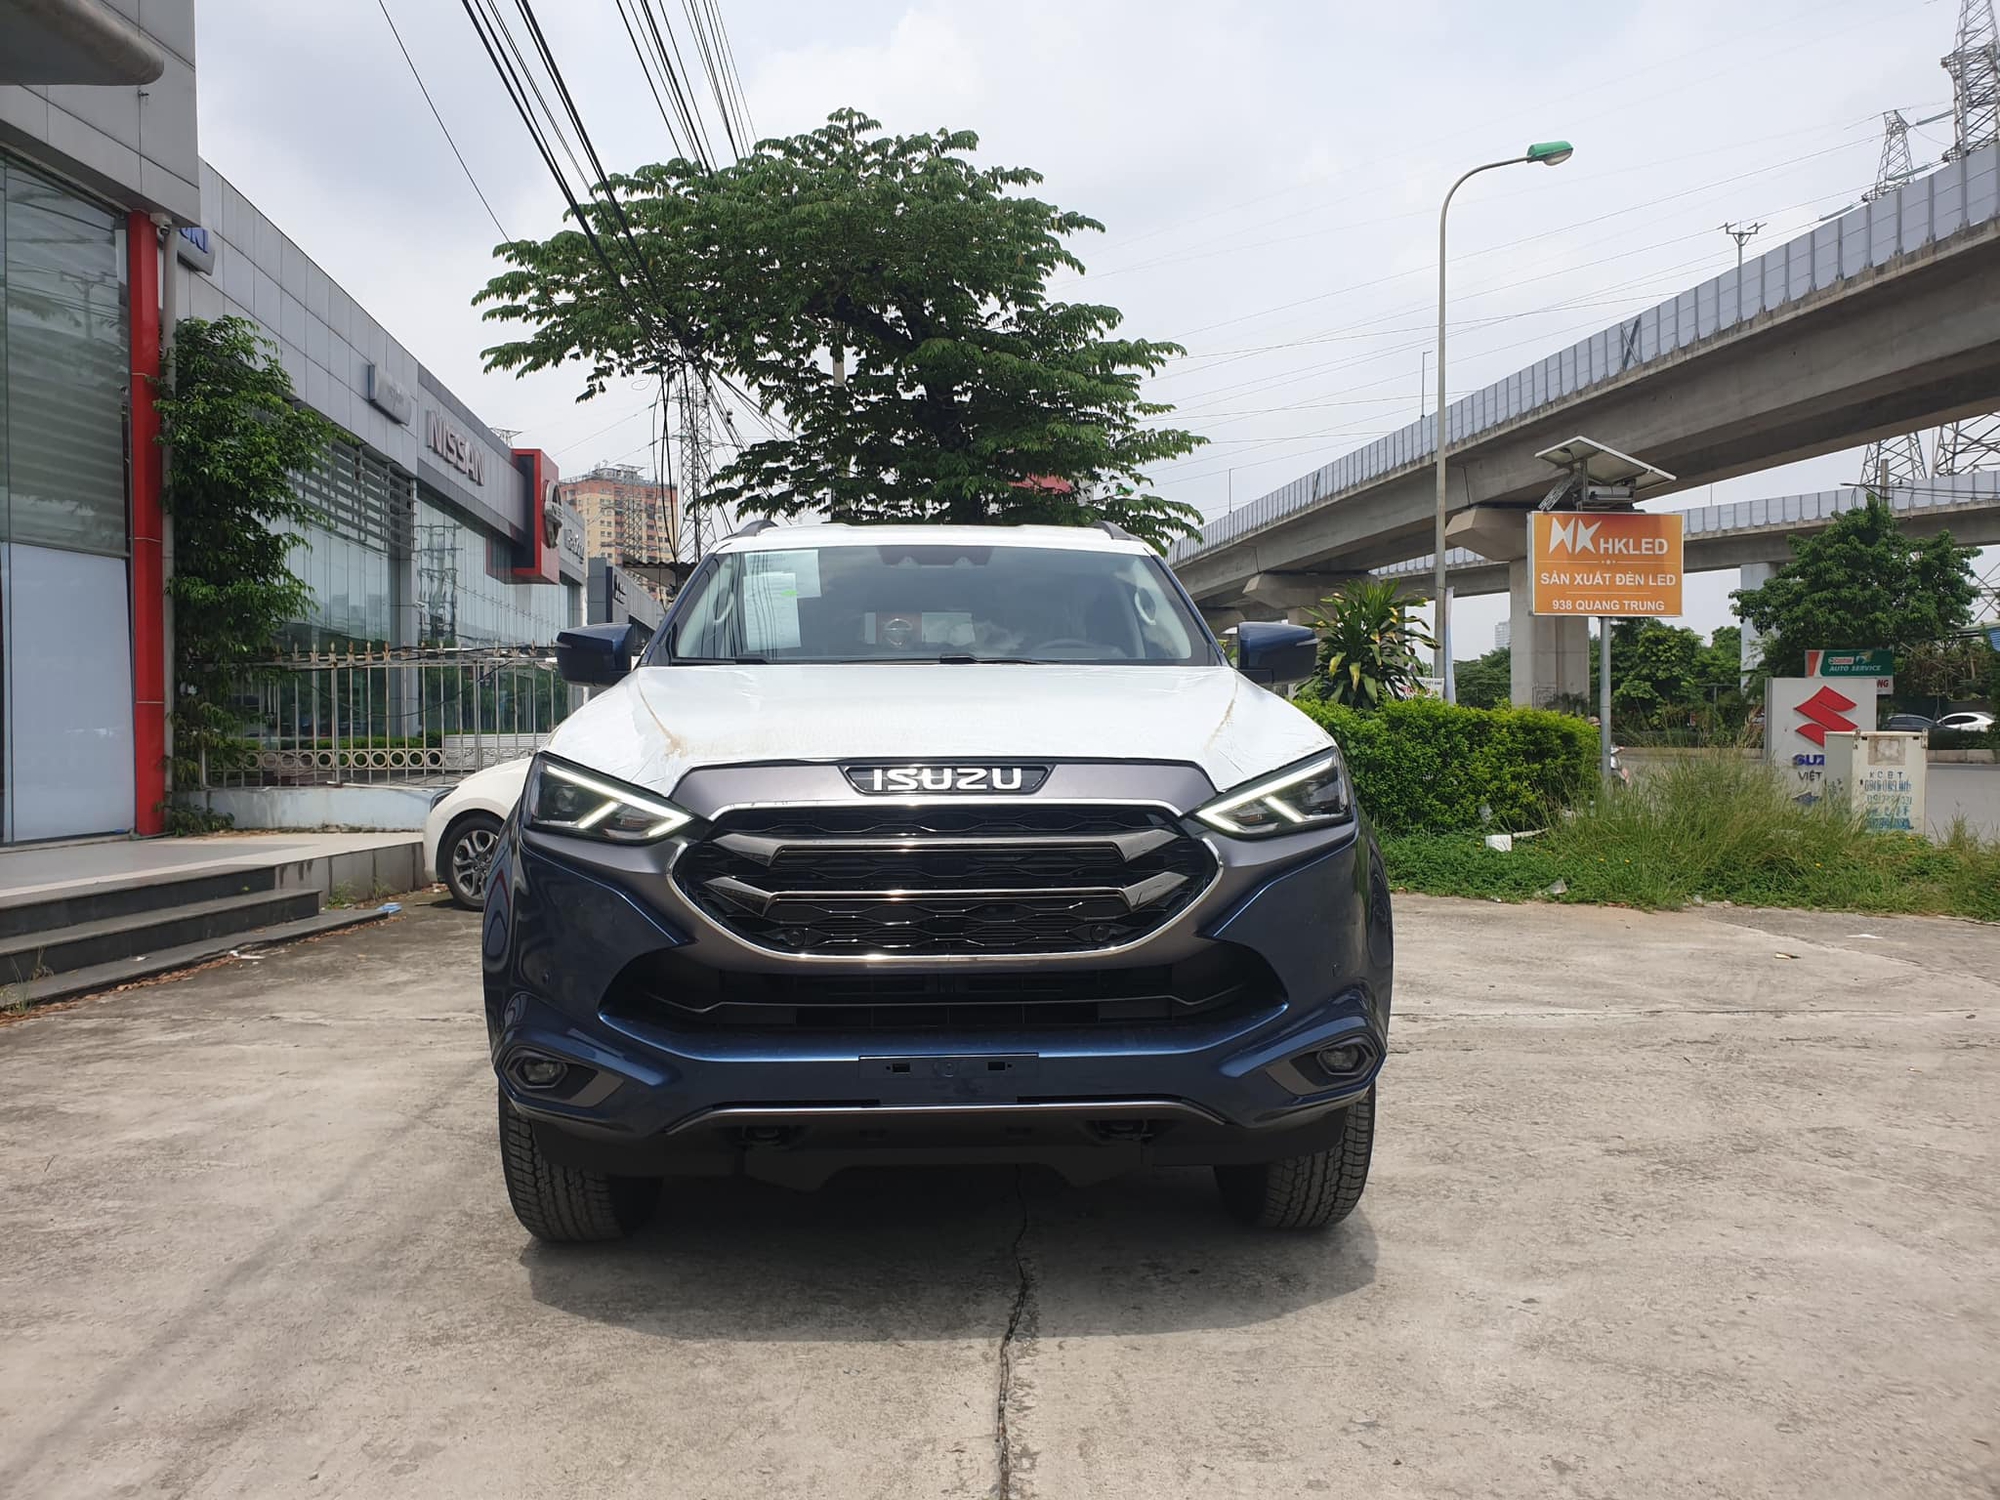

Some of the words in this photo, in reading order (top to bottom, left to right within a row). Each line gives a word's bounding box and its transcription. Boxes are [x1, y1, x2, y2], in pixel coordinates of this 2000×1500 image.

[426, 409, 484, 486] NISSAN
[1599, 537, 1669, 555] HKLED
[1648, 573, 1676, 586] LED
[1552, 599, 1573, 610] 938
[1575, 600, 1620, 611] QUANG
[1623, 600, 1665, 611] TRUNG
[873, 767, 1022, 791] ISUZU
